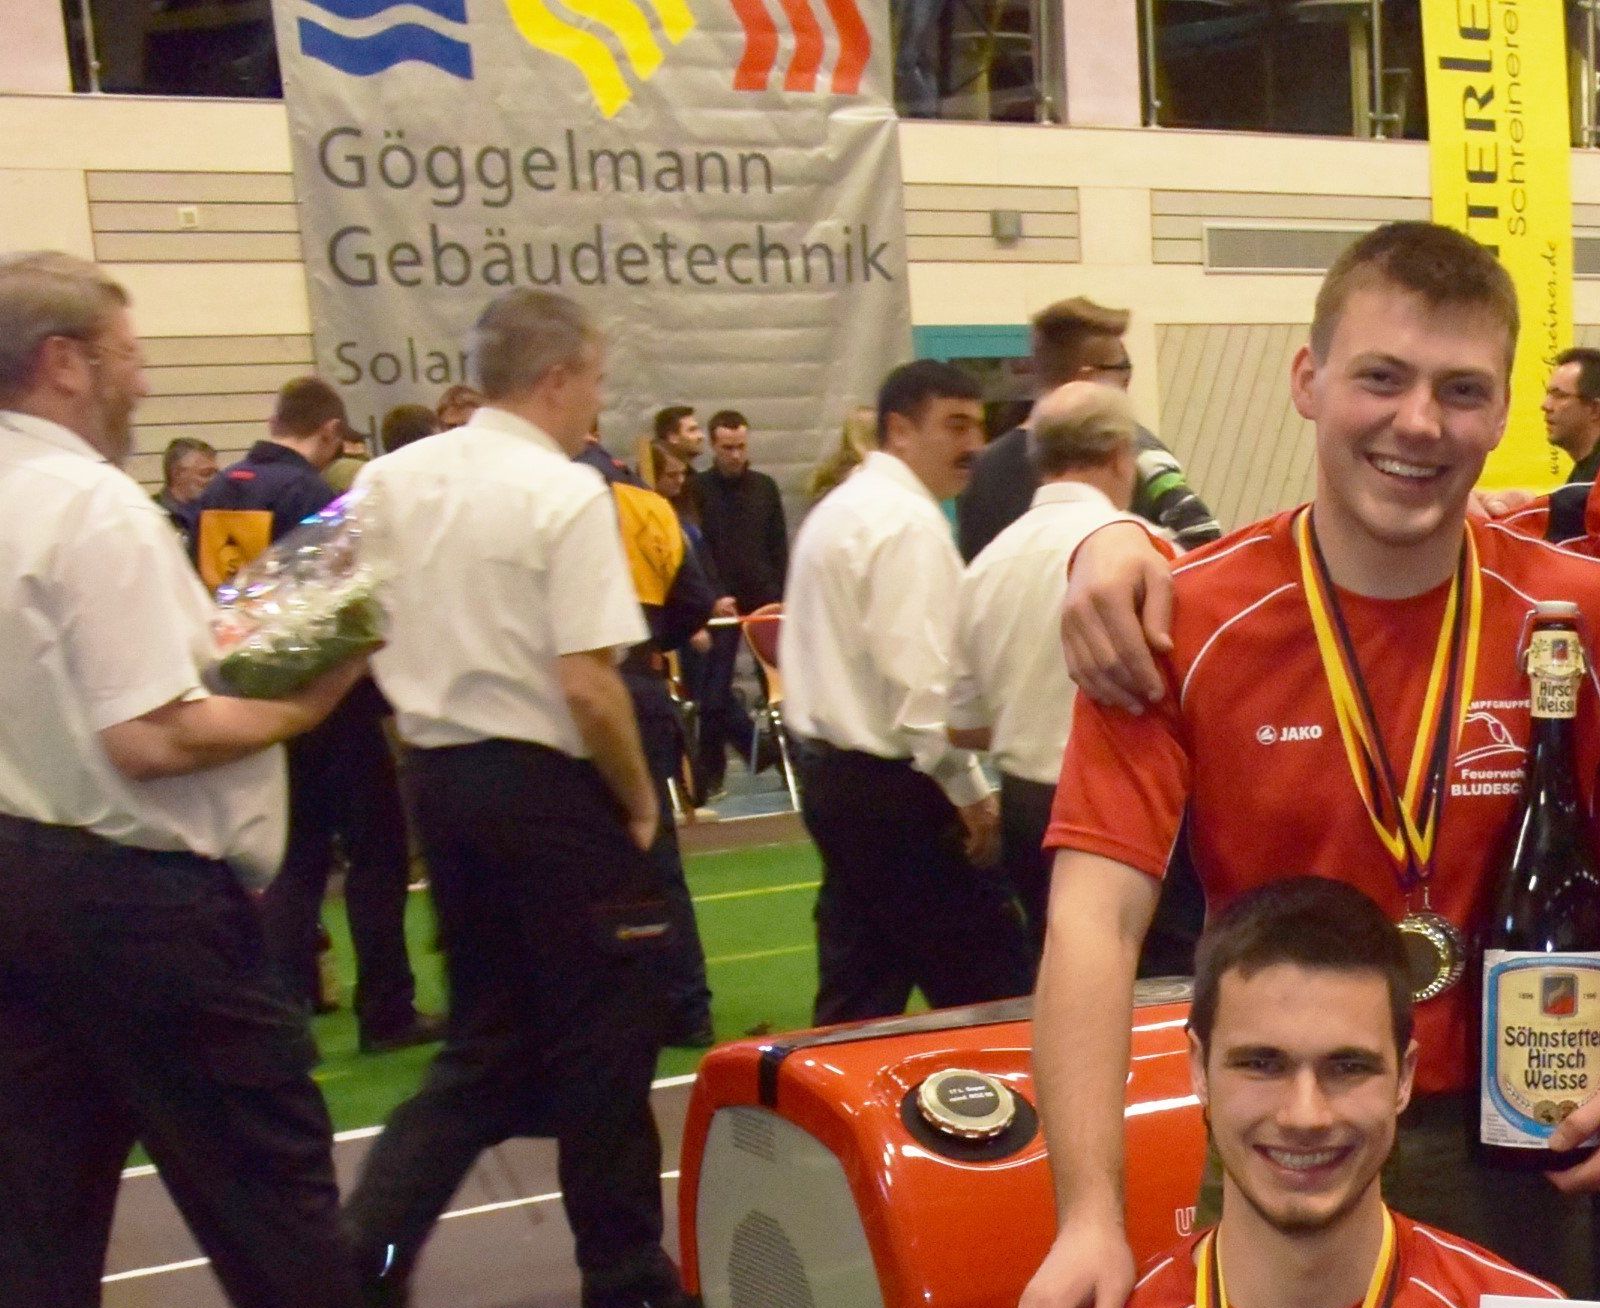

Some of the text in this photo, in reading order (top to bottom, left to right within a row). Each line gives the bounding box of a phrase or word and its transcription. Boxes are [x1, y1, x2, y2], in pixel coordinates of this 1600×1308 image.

[318, 127, 774, 208] Göggelmann
[327, 224, 893, 288] Gebäudetechnik
[1539, 681, 1573, 697] Hirsc
[1536, 697, 1575, 713] Weiss
[1280, 725, 1322, 742] JAKO
[1461, 768, 1525, 780] Feuerweh
[1451, 782, 1521, 796] BLUDESC
[1528, 1049, 1585, 1069] Hirsch
[1524, 1070, 1588, 1090] Weisse
